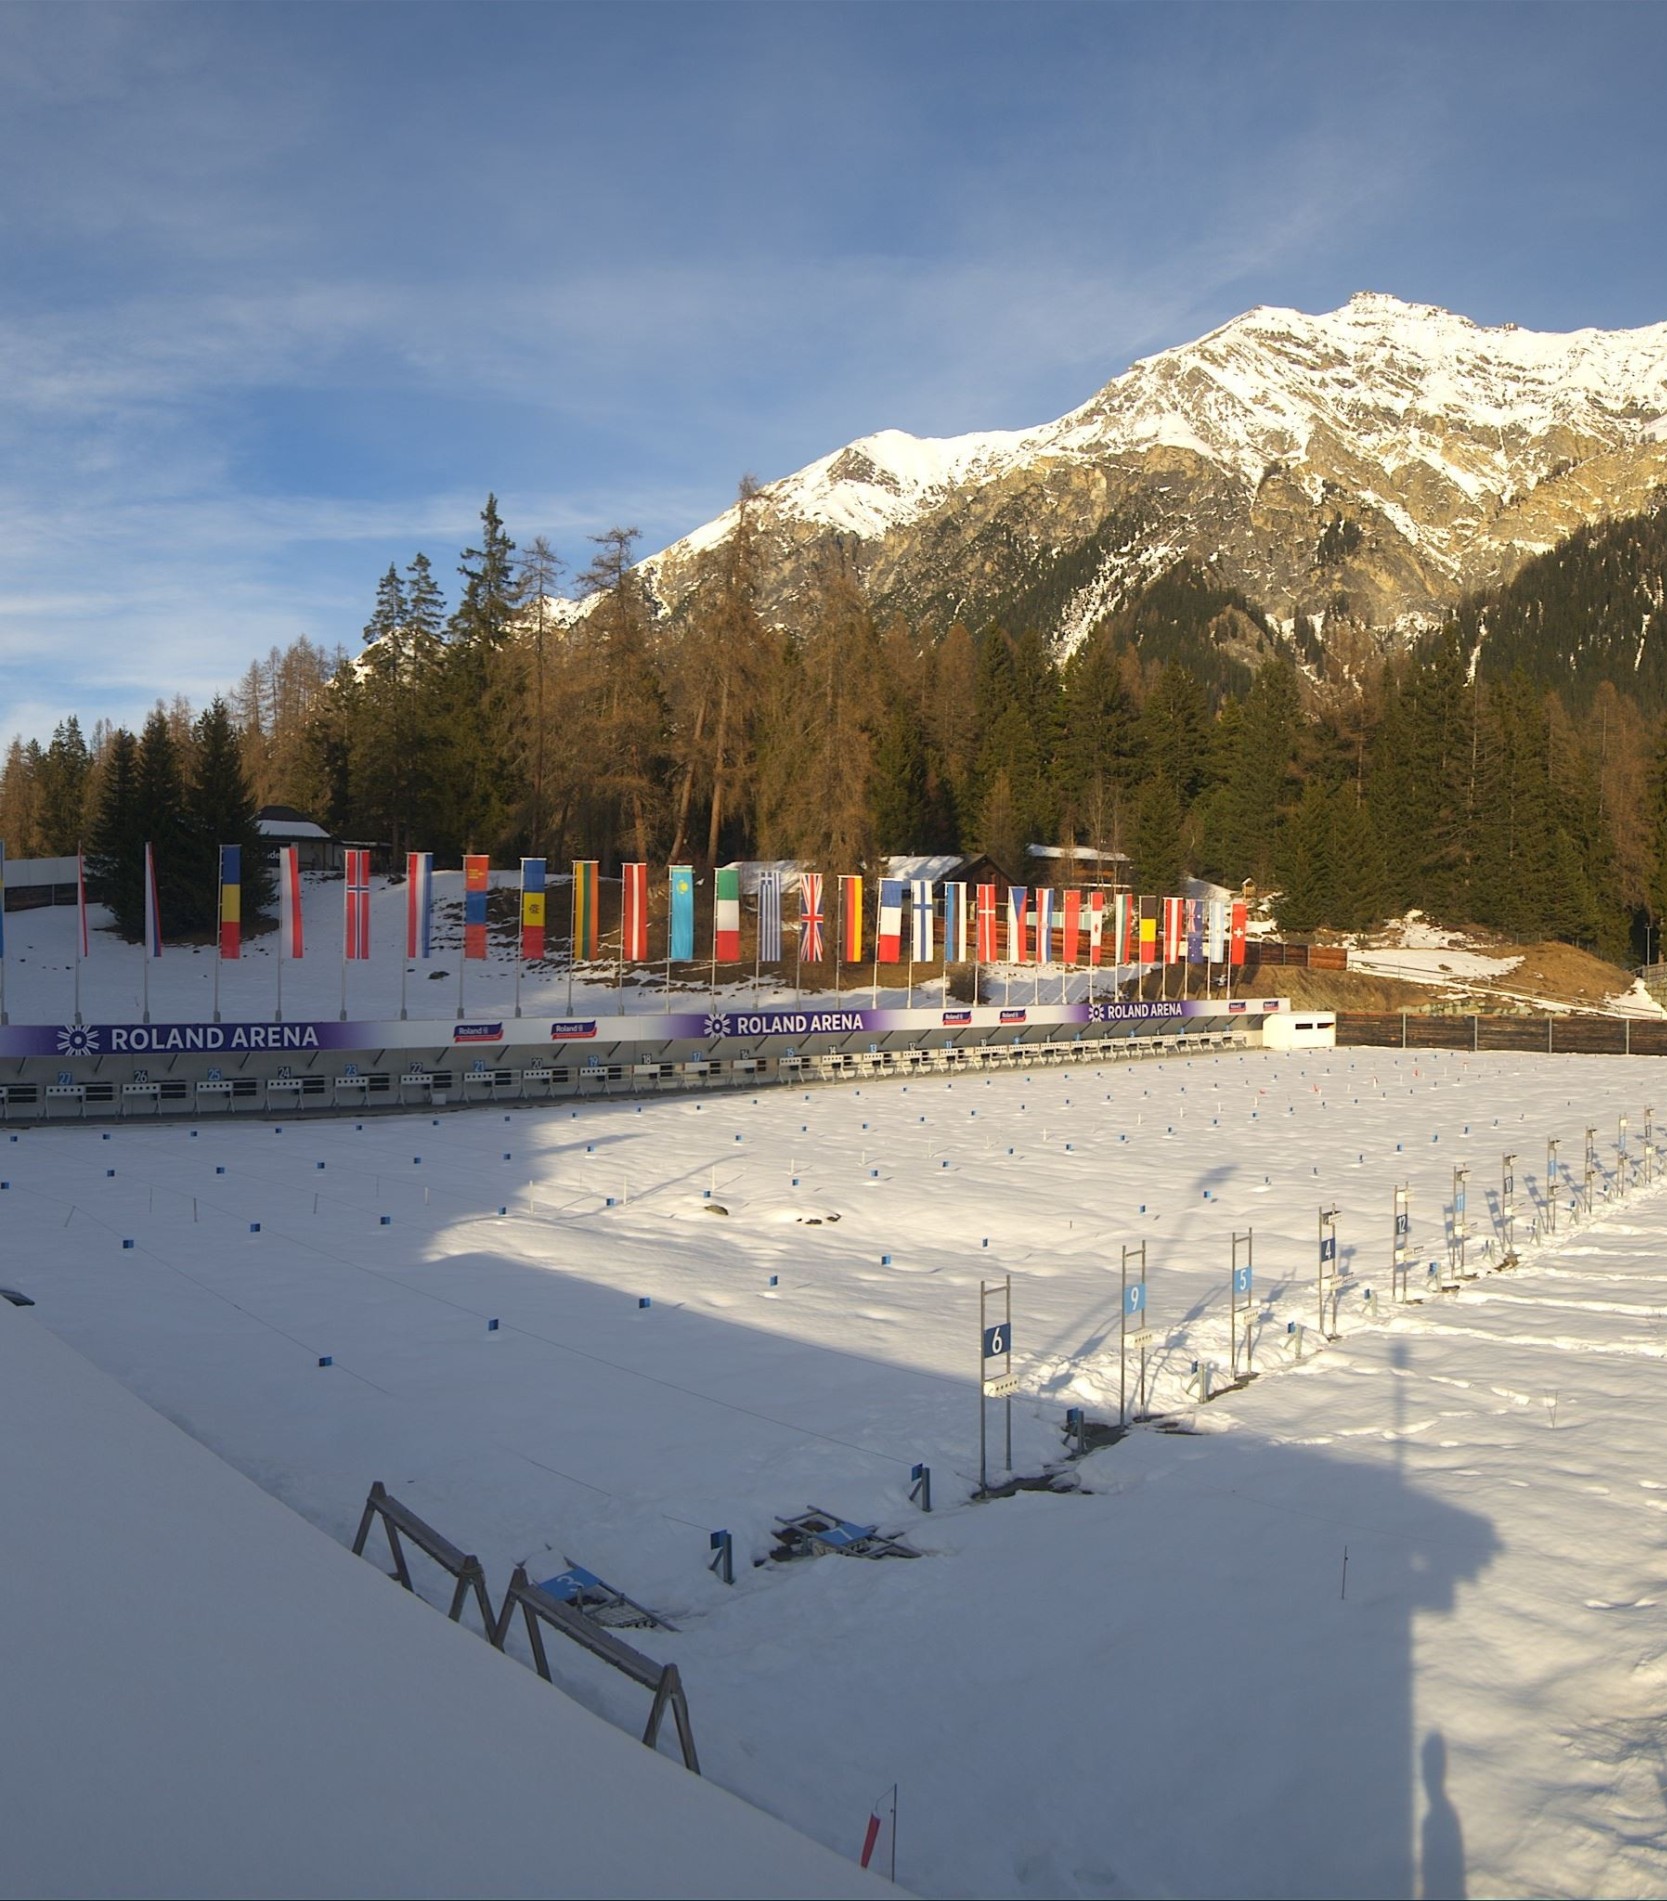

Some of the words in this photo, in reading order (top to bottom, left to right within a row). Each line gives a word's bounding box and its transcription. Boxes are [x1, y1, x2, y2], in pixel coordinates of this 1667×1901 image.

[1108, 1003, 1149, 1018] ROLAND
[1150, 1002, 1183, 1016] ARENA
[738, 1015, 807, 1034] ROLAND
[811, 1014, 863, 1032] ARENA
[112, 1027, 224, 1050] ROLAND
[231, 1025, 320, 1049] ARENA
[532, 1059, 542, 1069] 20
[642, 1054, 652, 1064] 18
[346, 1065, 357, 1076] 23
[411, 1063, 422, 1074] 22
[474, 1061, 485, 1072] 21
[135, 1071, 147, 1082] 26
[208, 1069, 220, 1080] 25
[279, 1067, 291, 1078] 24
[59, 1073, 71, 1084] 27
[1397, 1216, 1407, 1233] 12
[1325, 1242, 1332, 1259] 4
[1240, 1271, 1247, 1290] 5
[1130, 1287, 1139, 1311] 9
[993, 1328, 1003, 1354] 6
